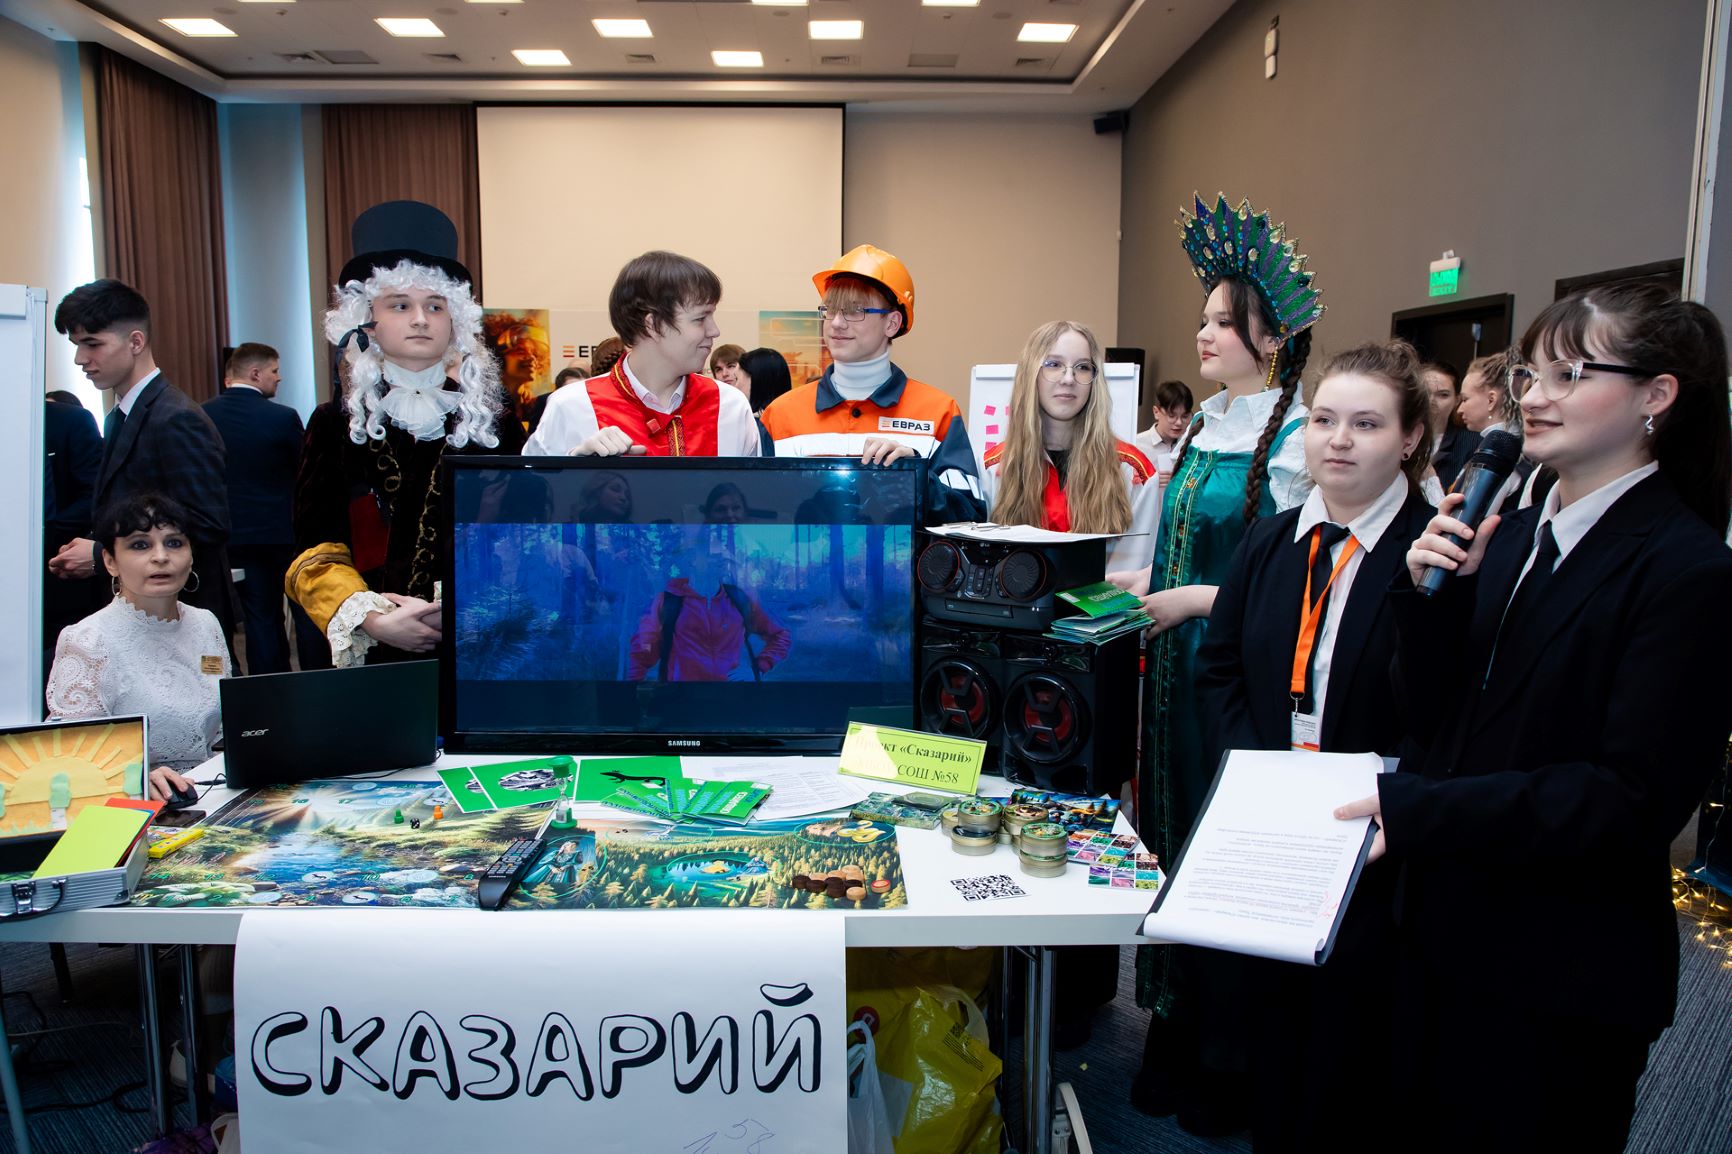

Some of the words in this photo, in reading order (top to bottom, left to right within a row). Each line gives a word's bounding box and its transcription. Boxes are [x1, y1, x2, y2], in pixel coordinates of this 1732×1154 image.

[892, 420, 931, 431] ЕВРАЗ
[241, 728, 270, 738] acer
[899, 743, 972, 763] «Сказарий»
[897, 764, 929, 780] СОШ
[930, 769, 960, 784] №58
[250, 982, 823, 1101] СКАЗАРИЙ
